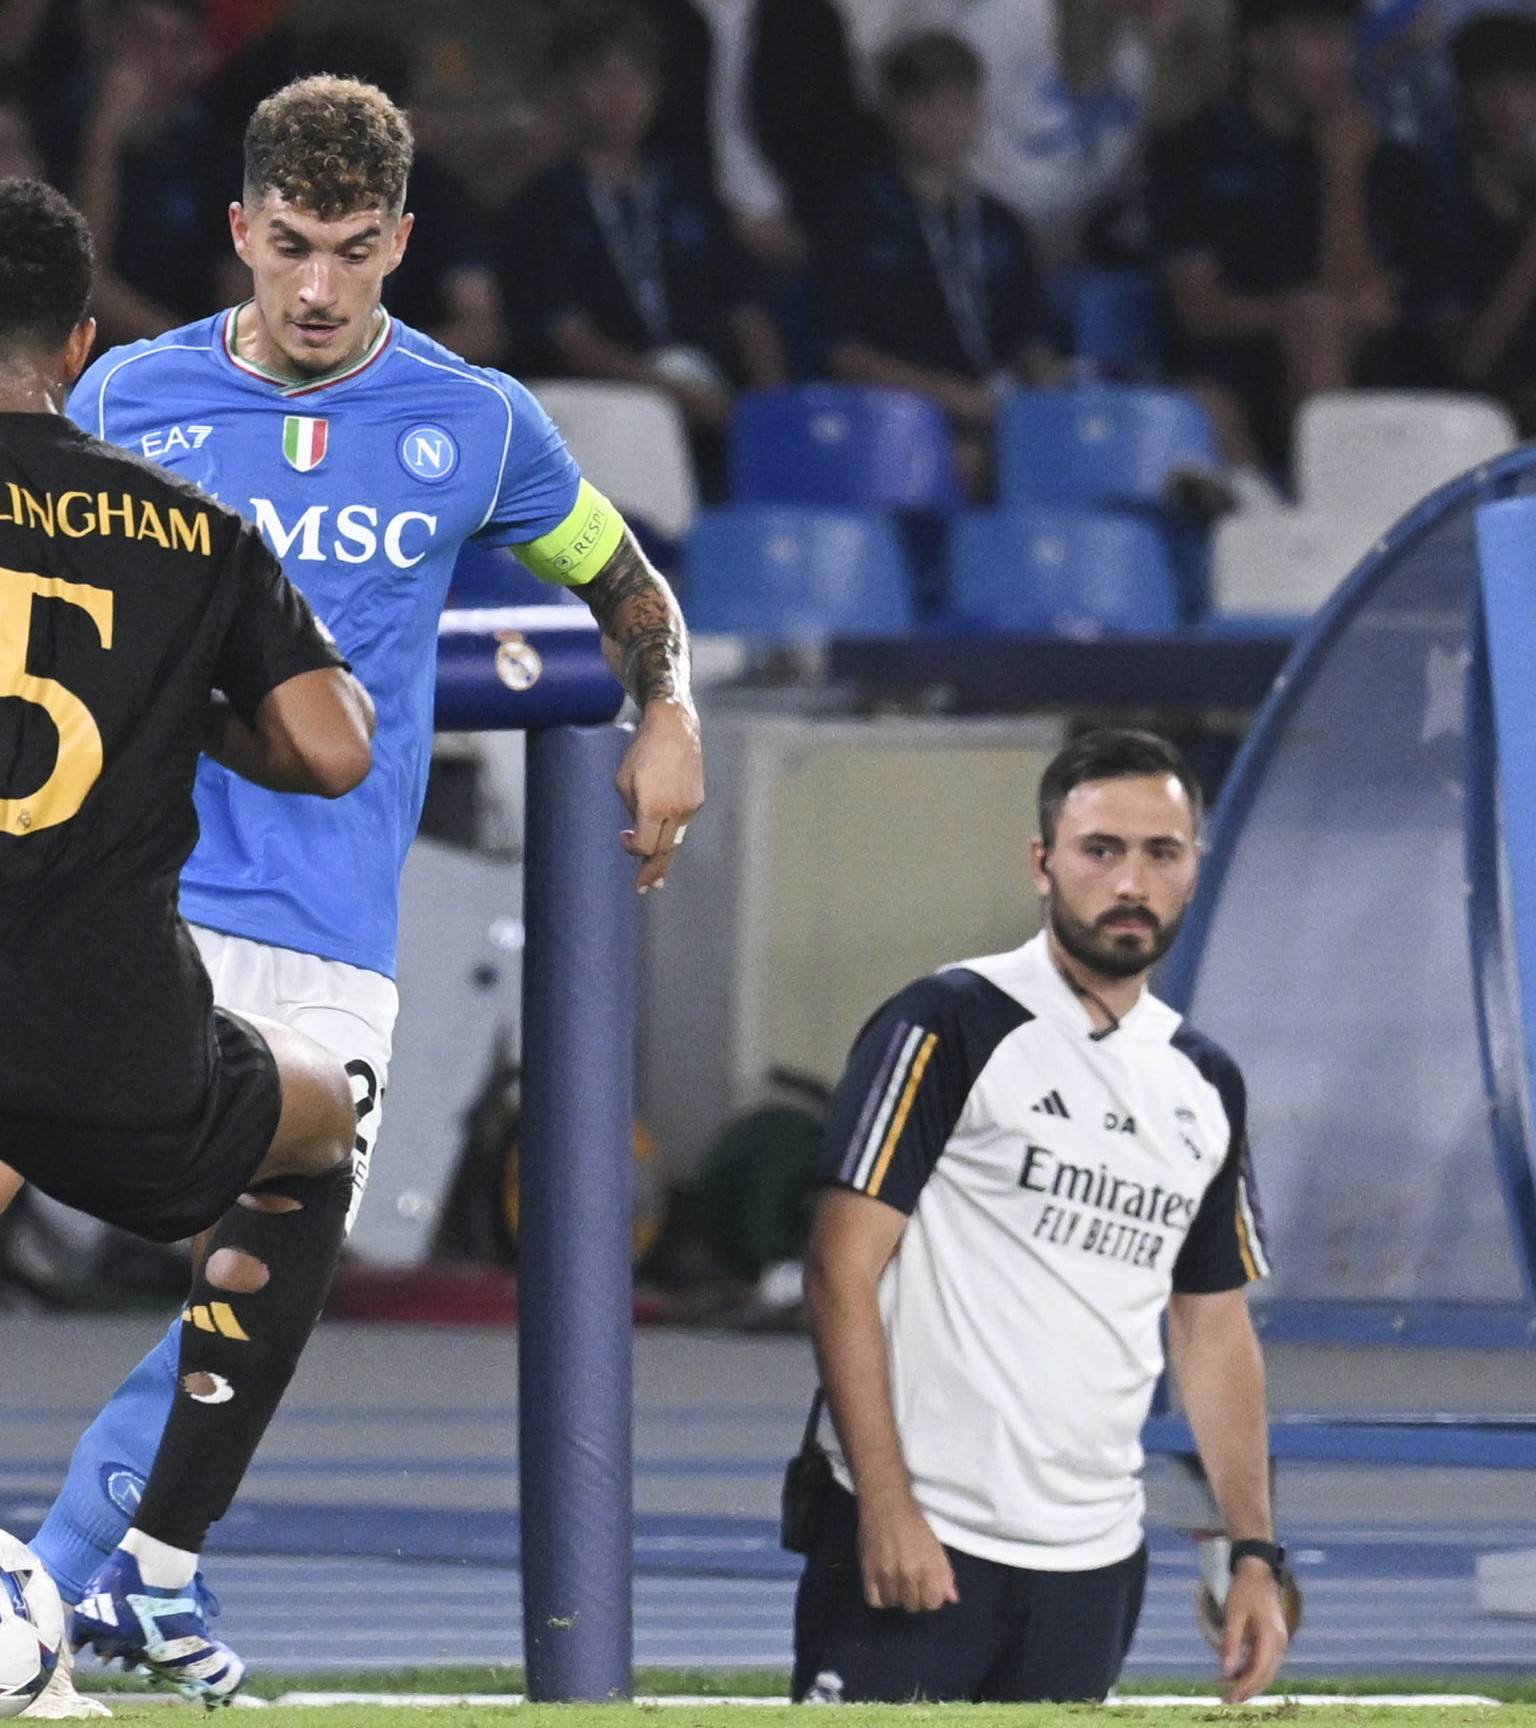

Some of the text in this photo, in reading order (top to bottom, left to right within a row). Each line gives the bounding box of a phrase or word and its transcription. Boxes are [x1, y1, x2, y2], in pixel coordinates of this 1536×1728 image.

[141, 425, 213, 458] EA7
[414, 437, 443, 469] N
[249, 497, 438, 569] MSC
[1103, 1112, 1137, 1135] DA
[1032, 1203, 1164, 1270] FLY BETTER
